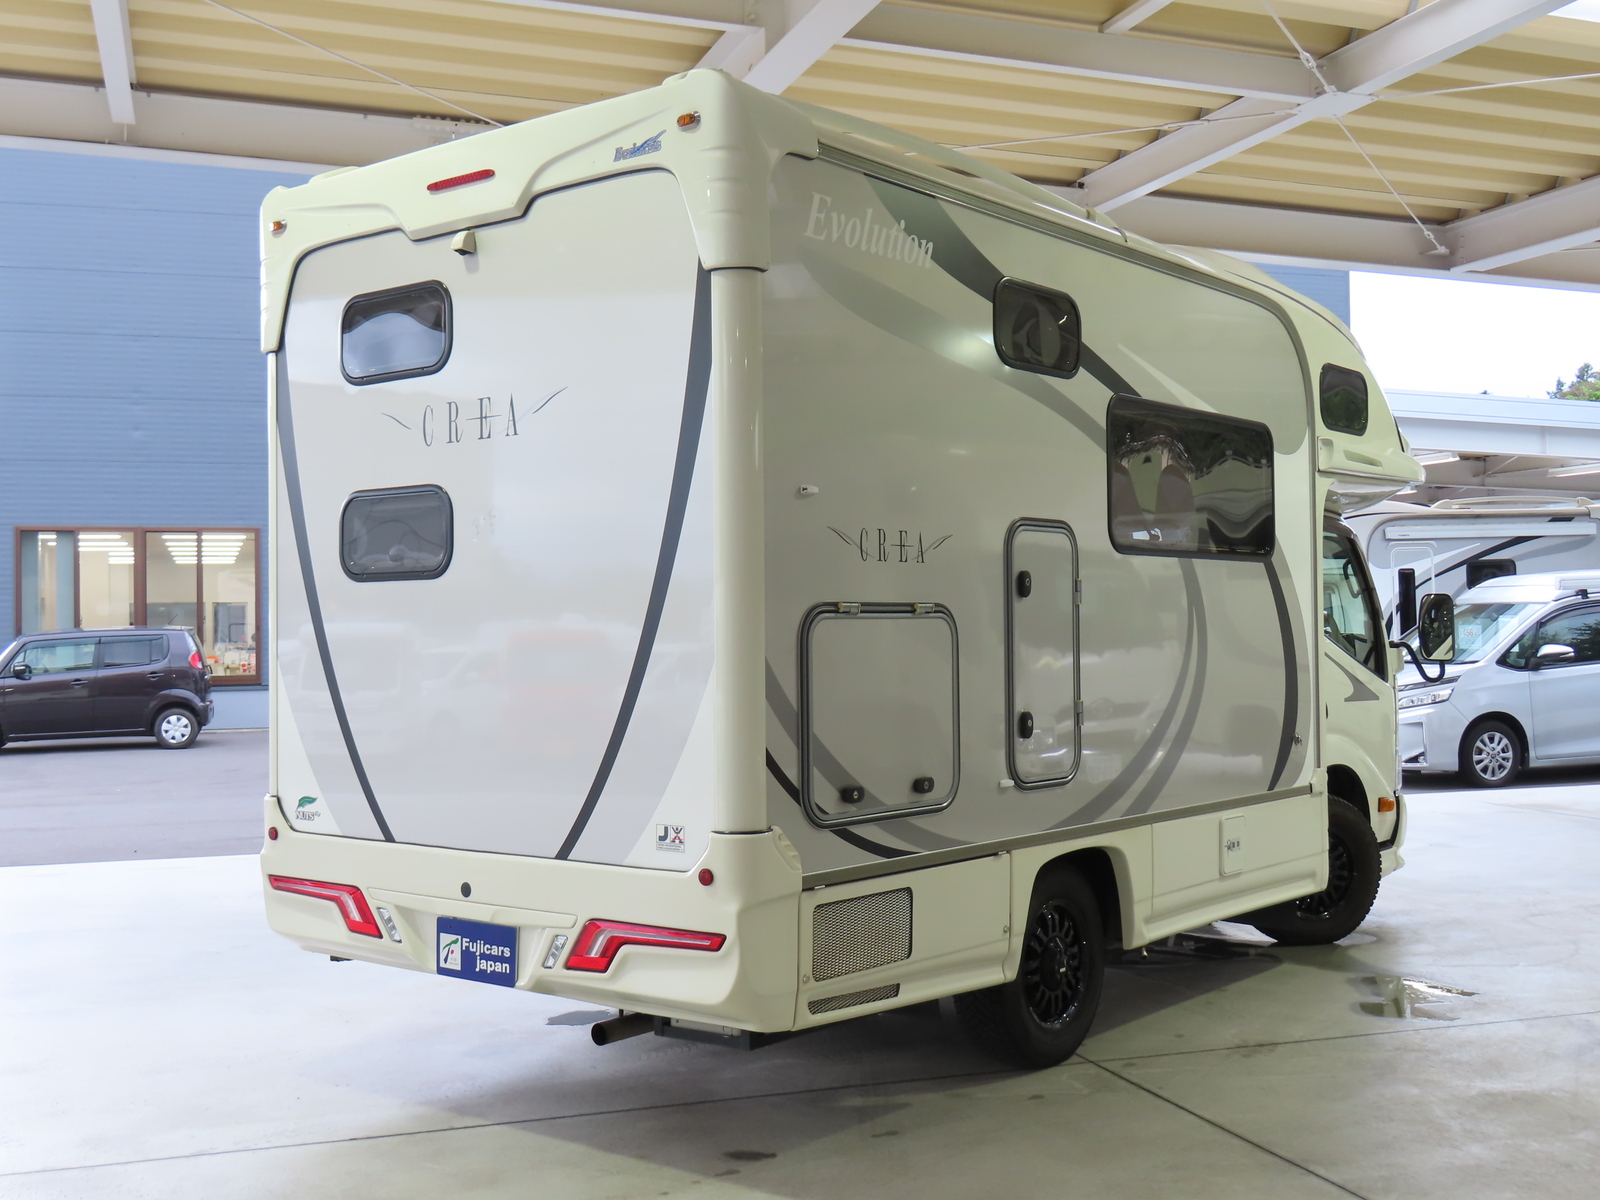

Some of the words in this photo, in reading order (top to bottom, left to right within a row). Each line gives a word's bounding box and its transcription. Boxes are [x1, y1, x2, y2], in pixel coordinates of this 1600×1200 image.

[803, 191, 934, 269] Evolution
[422, 392, 519, 447] CREA
[860, 527, 925, 564] CREA
[462, 937, 511, 958] Fujicars
[475, 956, 510, 974] japan
